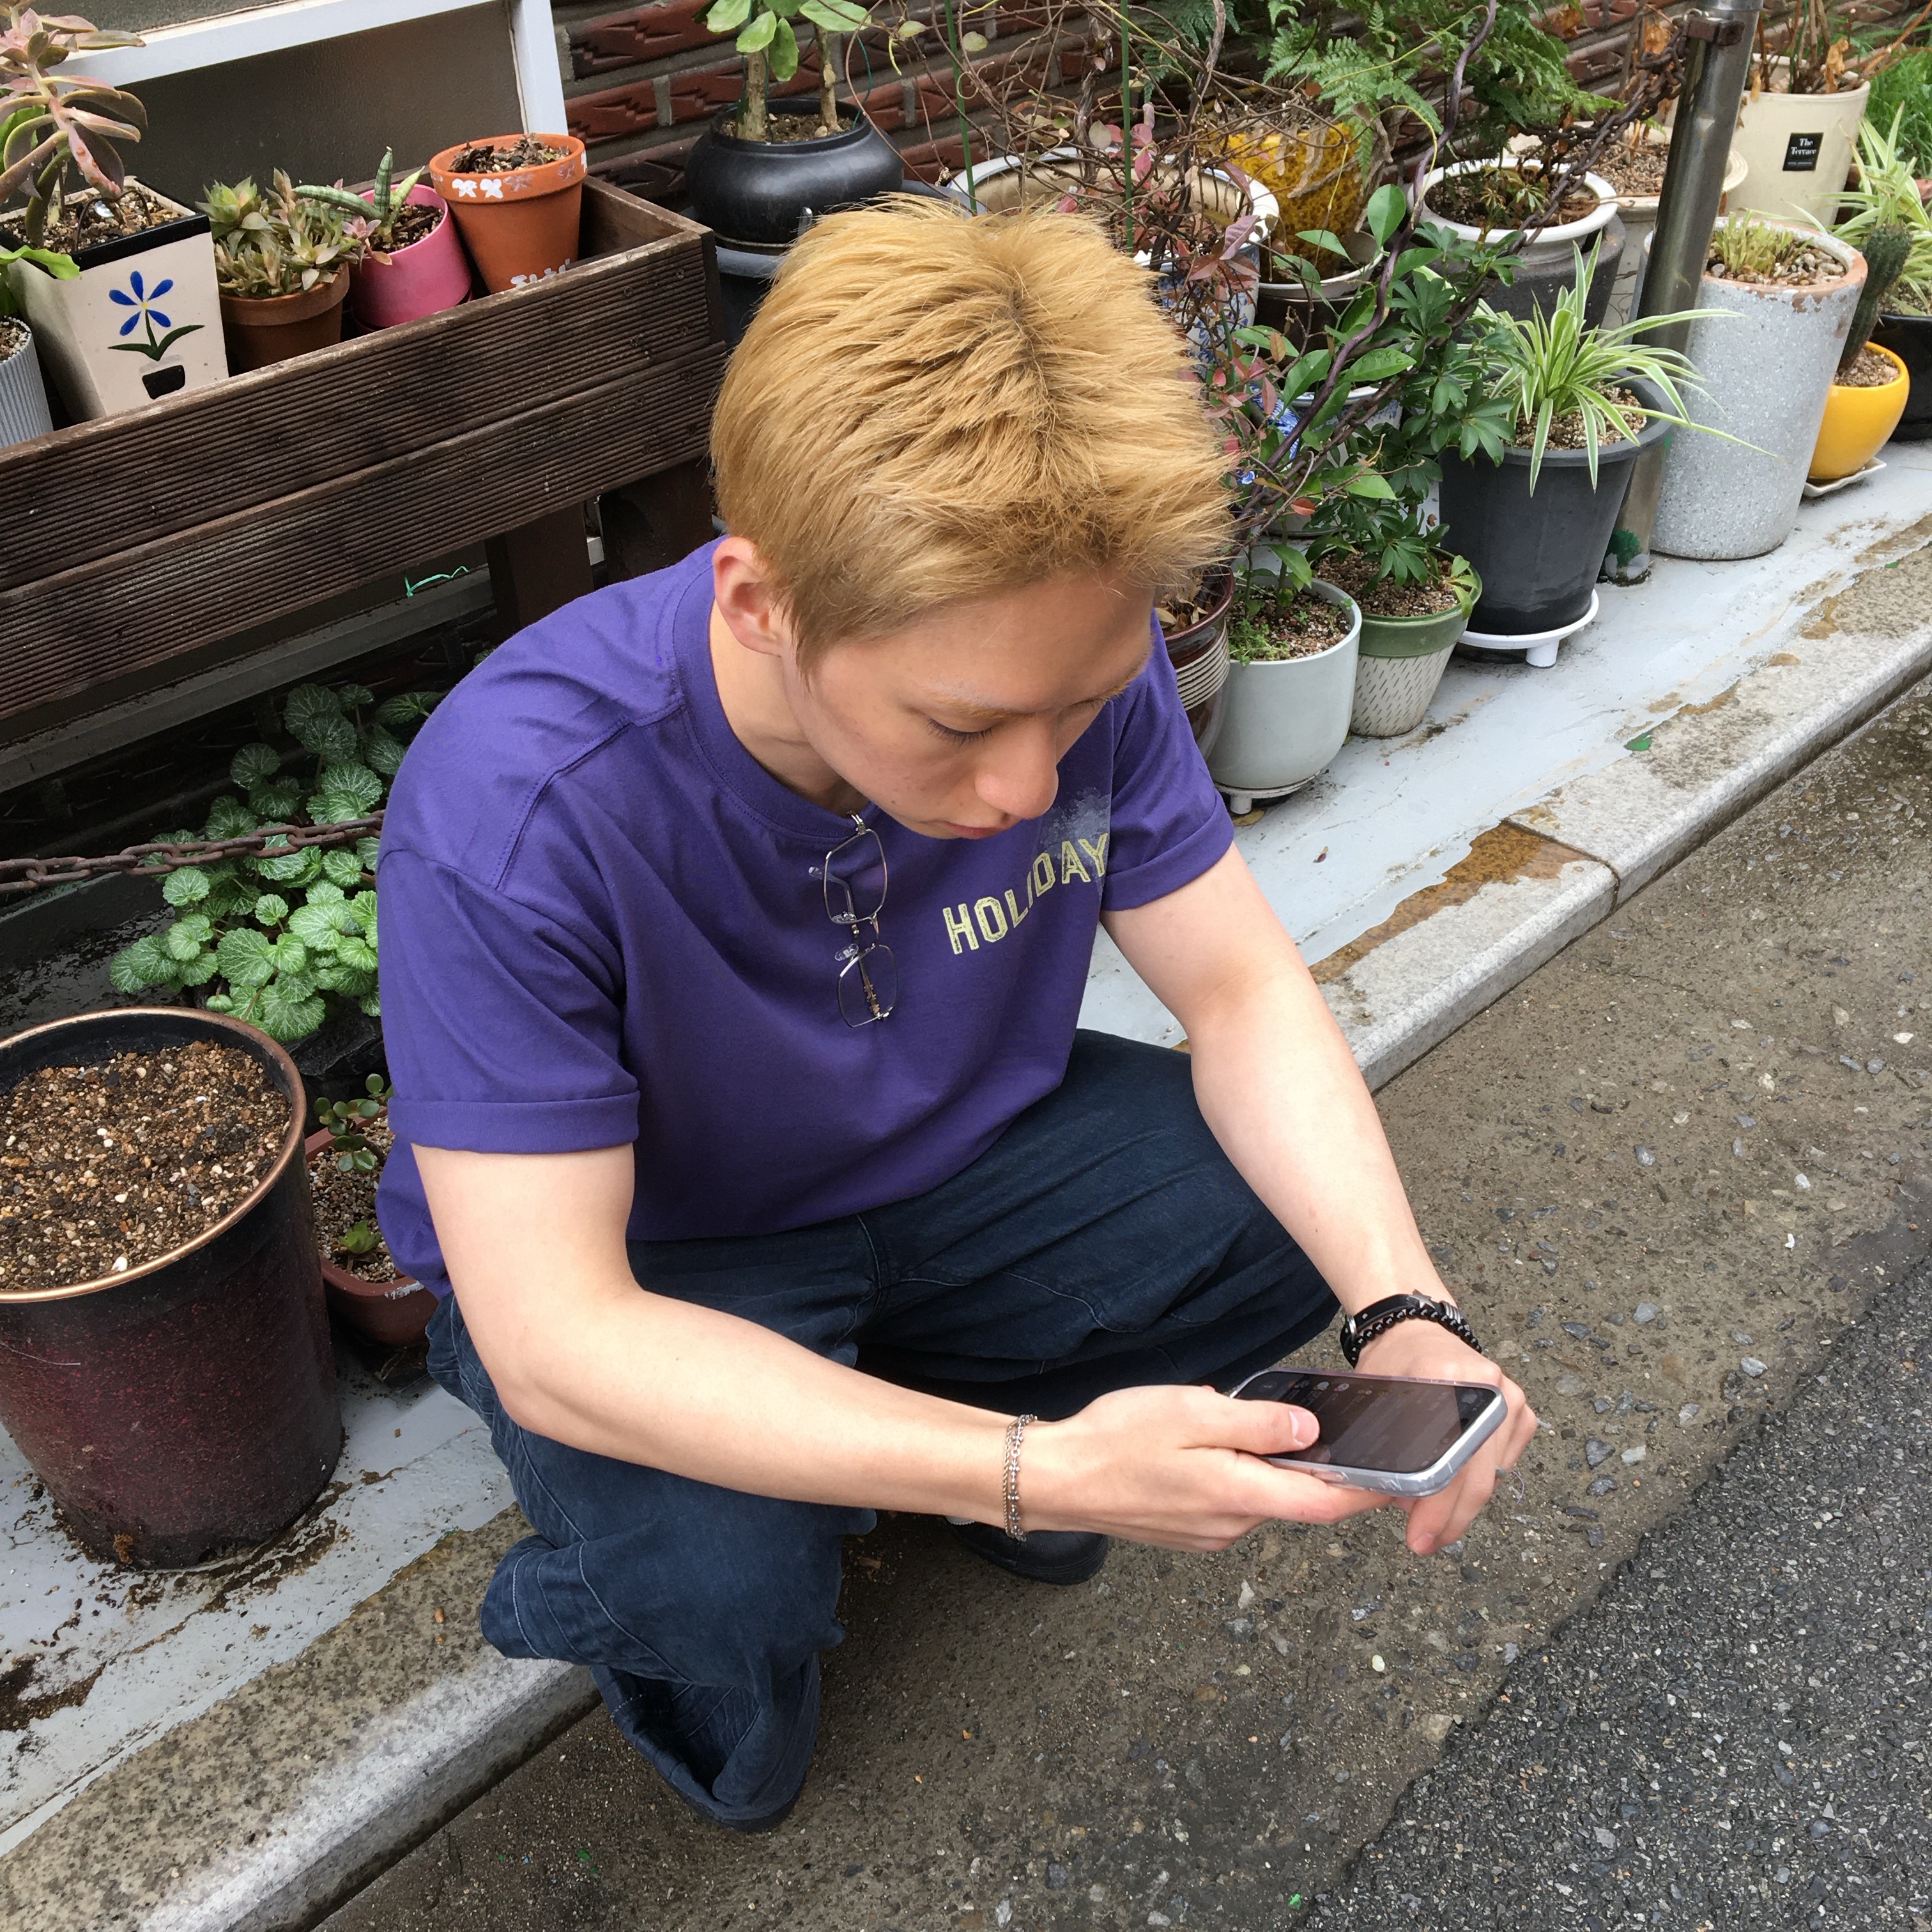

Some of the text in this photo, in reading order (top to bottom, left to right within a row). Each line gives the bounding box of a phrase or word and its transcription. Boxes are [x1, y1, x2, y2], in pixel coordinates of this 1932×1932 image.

[1799, 138, 1813, 146] The
[1791, 146, 1816, 155] Terrace
[942, 832, 1108, 954] HOLIDAY
